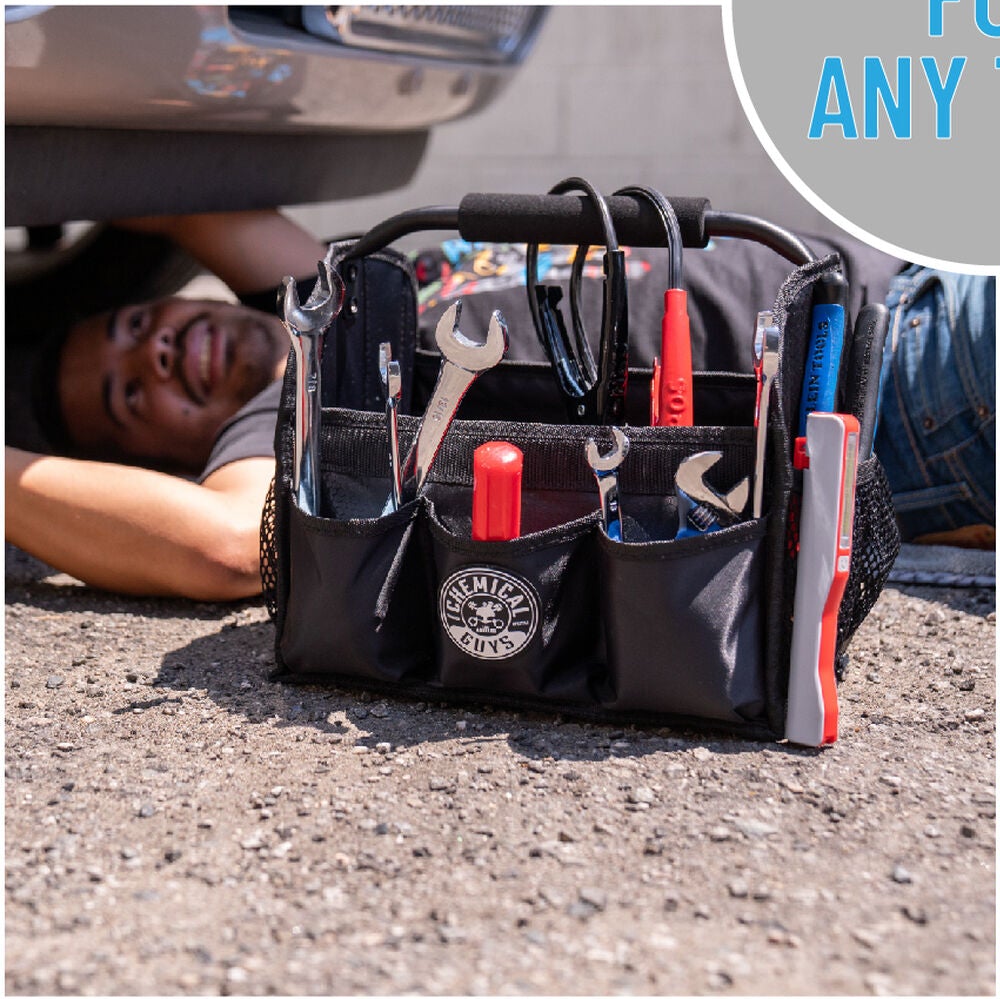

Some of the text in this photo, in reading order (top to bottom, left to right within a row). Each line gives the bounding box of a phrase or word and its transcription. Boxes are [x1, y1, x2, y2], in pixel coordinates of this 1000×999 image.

[812, 320, 829, 369] TOOLS
[446, 576, 529, 617] CHEMICAL
[461, 632, 514, 653] GUYS
